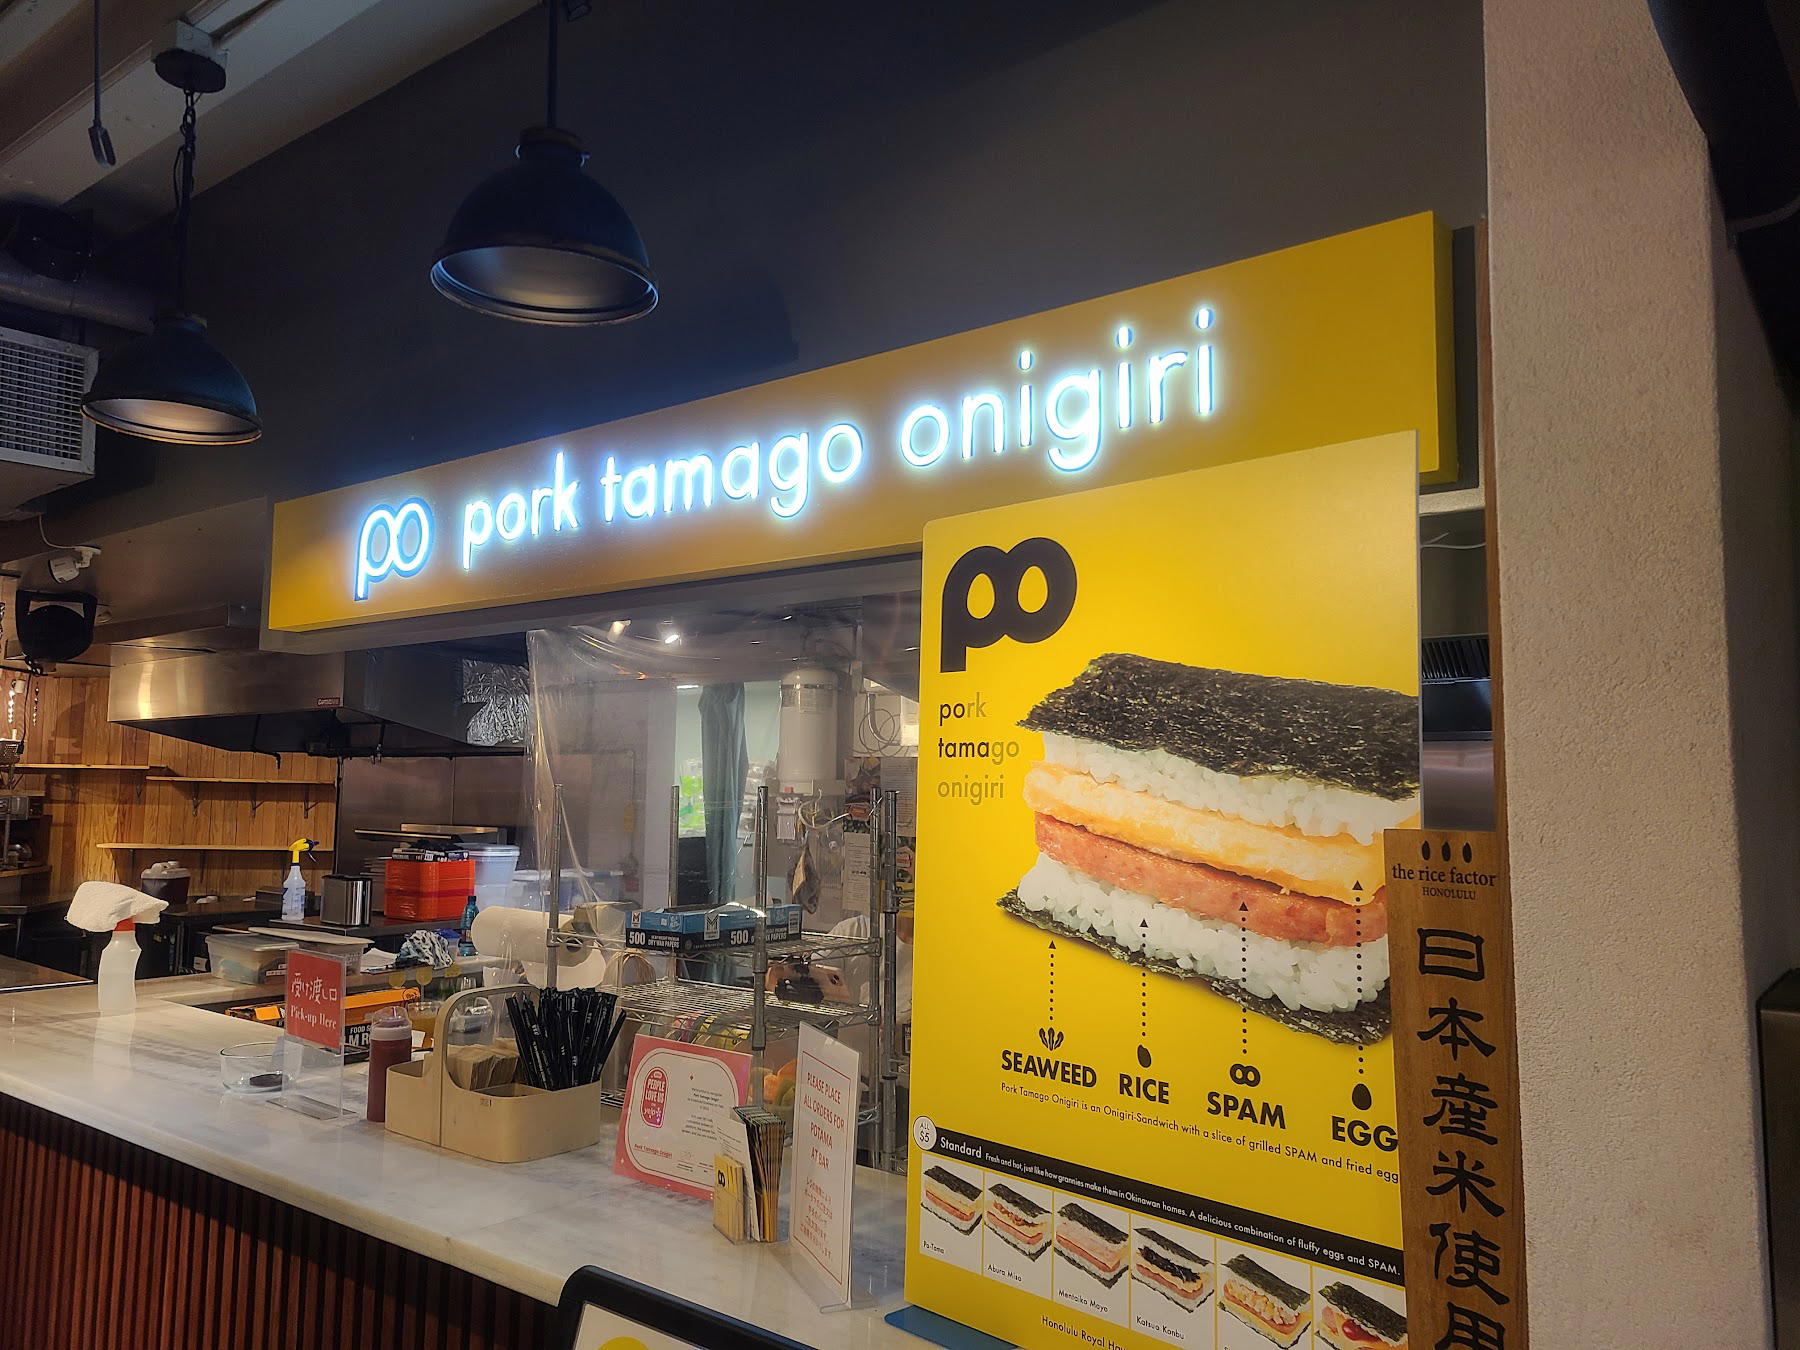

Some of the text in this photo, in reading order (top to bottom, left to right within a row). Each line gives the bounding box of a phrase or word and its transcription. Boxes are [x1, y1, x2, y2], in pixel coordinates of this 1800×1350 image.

[463, 308, 1214, 569] pork tamago onigiri
[939, 692, 987, 726] pork
[938, 737, 1020, 765] tamago
[938, 775, 1004, 805] onigiri
[1392, 863, 1496, 887] the rice factor
[1422, 887, 1477, 900] HONOLULU
[629, 931, 646, 945] 500
[665, 940, 680, 948] PAPERS
[730, 930, 749, 945] 500
[771, 932, 787, 941] PAPERS
[291, 972, 337, 1004] 受け渡し口
[290, 1005, 337, 1030] Pick-up Here
[350, 1026, 366, 1034] FOOD
[1001, 1049, 1097, 1088] SEAWEED
[645, 1089, 665, 1104] LOVE US
[647, 1078, 666, 1092] PEOPLE
[807, 1072, 841, 1105] PLEASE PLACE
[1119, 1073, 1170, 1104] RICE
[803, 1095, 844, 1132] ALL ORDERS FOR
[1207, 1091, 1286, 1129] SPAM
[810, 1121, 833, 1150] POTAMA
[919, 1131, 930, 1143] $5
[1001, 1082, 1017, 1094] Pork
[1019, 1086, 1049, 1103] Tamago
[1052, 1093, 1079, 1111] Onigiri
[1081, 1101, 1088, 1110] is
[1091, 1105, 1101, 1113] an
[1104, 1105, 1179, 1132] Onigiri-Sandwich
[1181, 1122, 1200, 1136] with
[1211, 1128, 1232, 1144] slice
[1236, 1136, 1246, 1147] of
[1249, 1138, 1281, 1158] grilled
[1285, 1145, 1317, 1163] SPAM
[1322, 1153, 1342, 1168] and
[1346, 1158, 1372, 1175] fried
[1376, 1168, 1399, 1184] egg
[1331, 1116, 1398, 1152] EGG
[811, 1147, 829, 1171] AT BAR
[940, 1136, 1401, 1276] Standard Fresh and hot, just like how grannies make them in Okinawan homes. A delicious combination of fluffy eggs and SPAM.
[987, 1264, 1022, 1282] Abura Miso
[1058, 1289, 1109, 1313] Mentaiko Mayo
[1042, 1315, 1078, 1337] Honolulu
[1081, 1329, 1105, 1348] Royal
[1136, 1315, 1185, 1340] Katsuo Konbu
